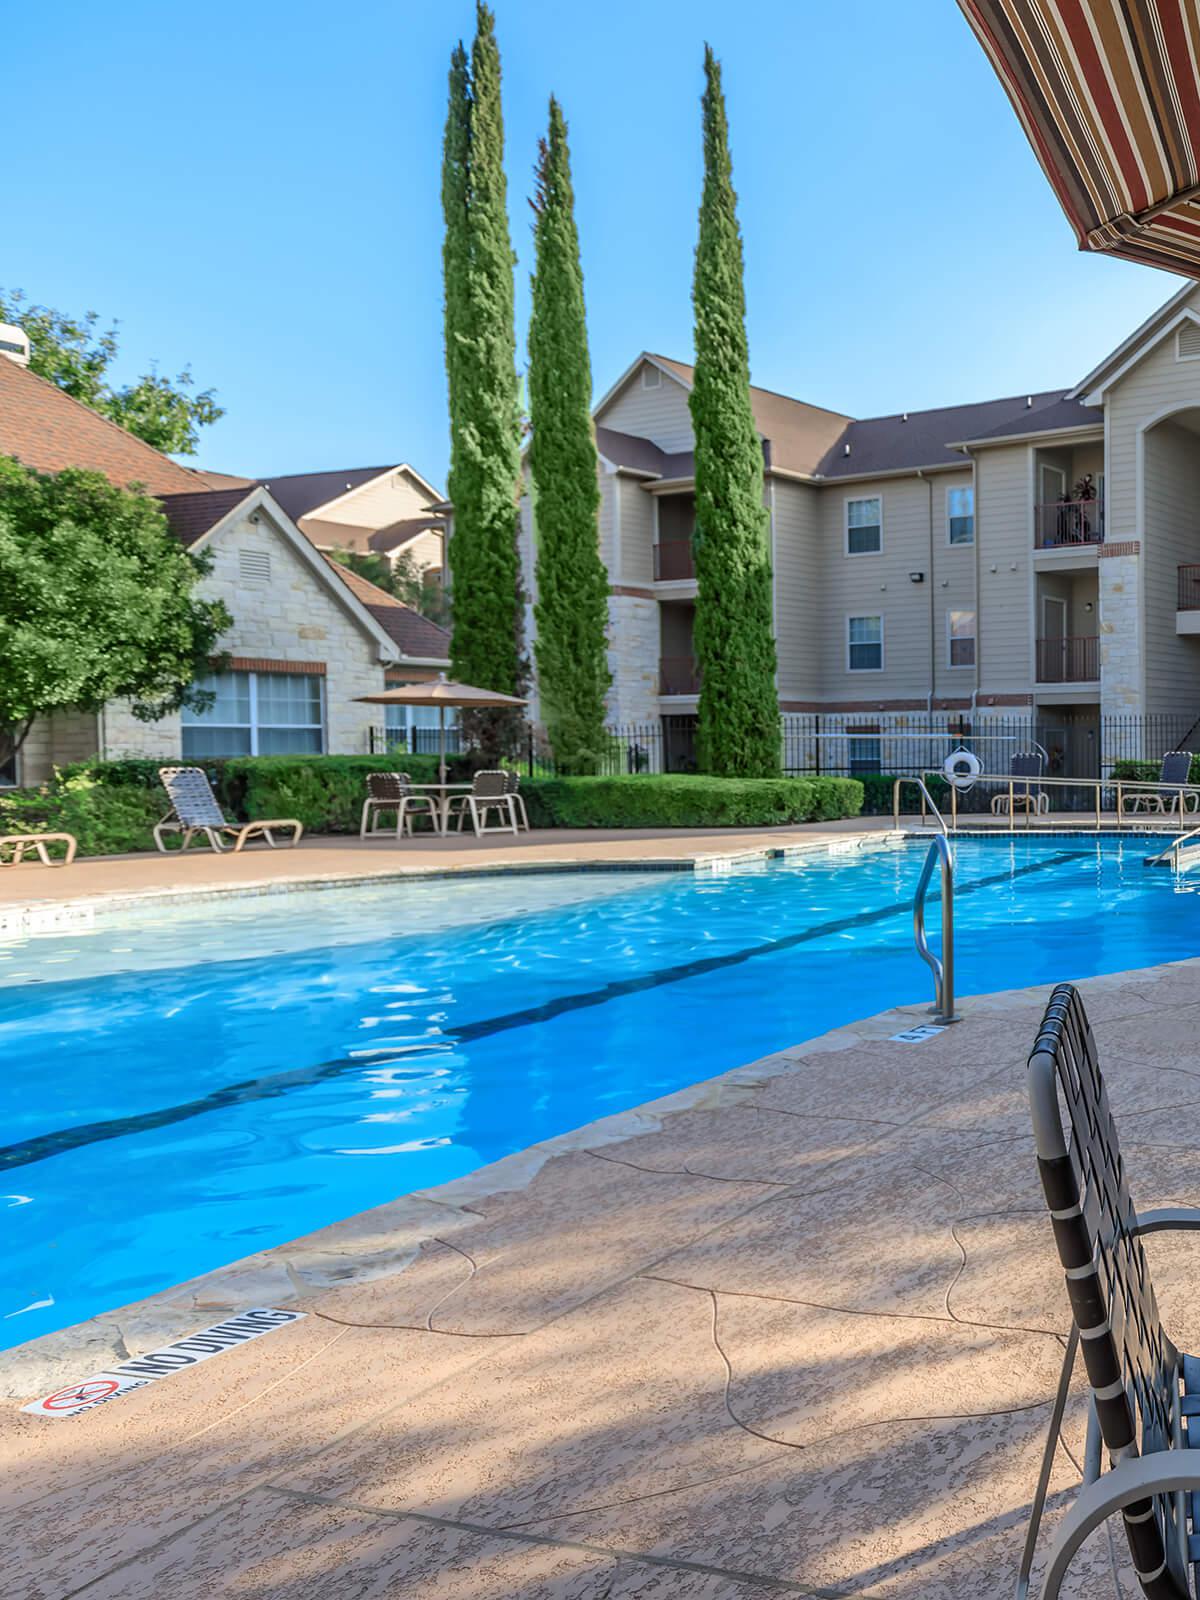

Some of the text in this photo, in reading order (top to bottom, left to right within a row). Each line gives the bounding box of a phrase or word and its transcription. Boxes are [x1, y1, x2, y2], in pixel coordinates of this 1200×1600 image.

[909, 1024, 945, 1035] FT
[117, 1311, 297, 1375] NO DIVING
[66, 1380, 149, 1417] NO DIVING
